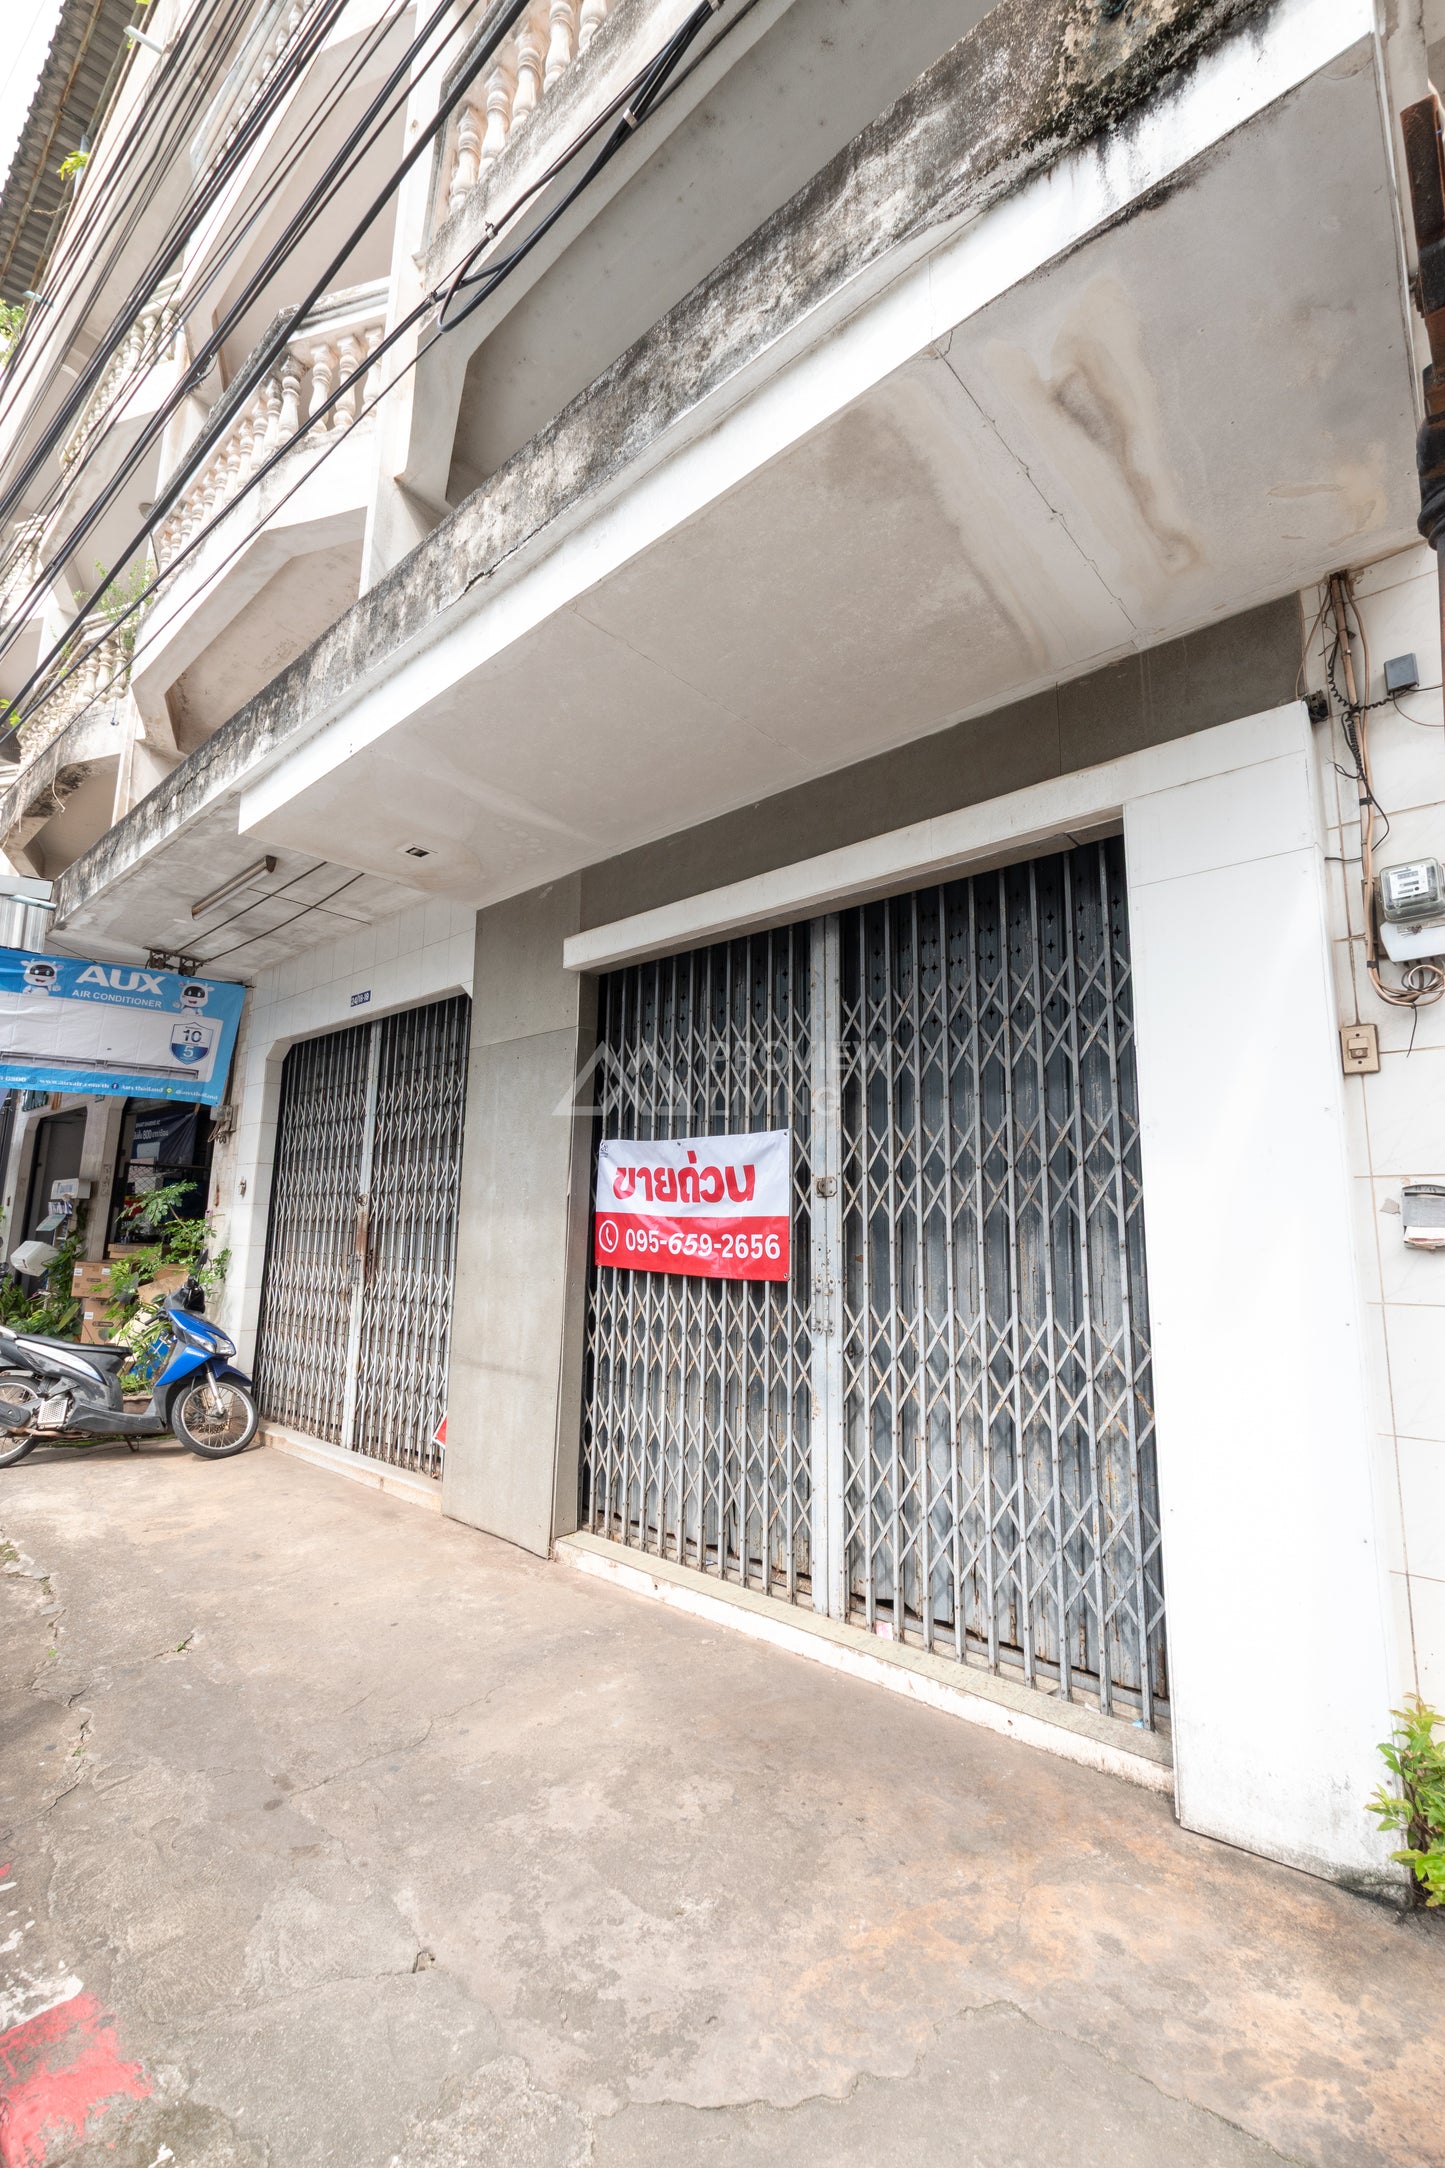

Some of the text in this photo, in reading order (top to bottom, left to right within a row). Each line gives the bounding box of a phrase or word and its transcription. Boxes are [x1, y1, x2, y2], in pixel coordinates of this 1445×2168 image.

[75, 965, 167, 996] AUX
[72, 989, 162, 1008] AIR CONDITIONER
[183, 1029, 202, 1043] 10
[183, 1045, 194, 1058] 5
[613, 1150, 755, 1203] ขายด่วน
[625, 1228, 781, 1260] 095-659-2656
